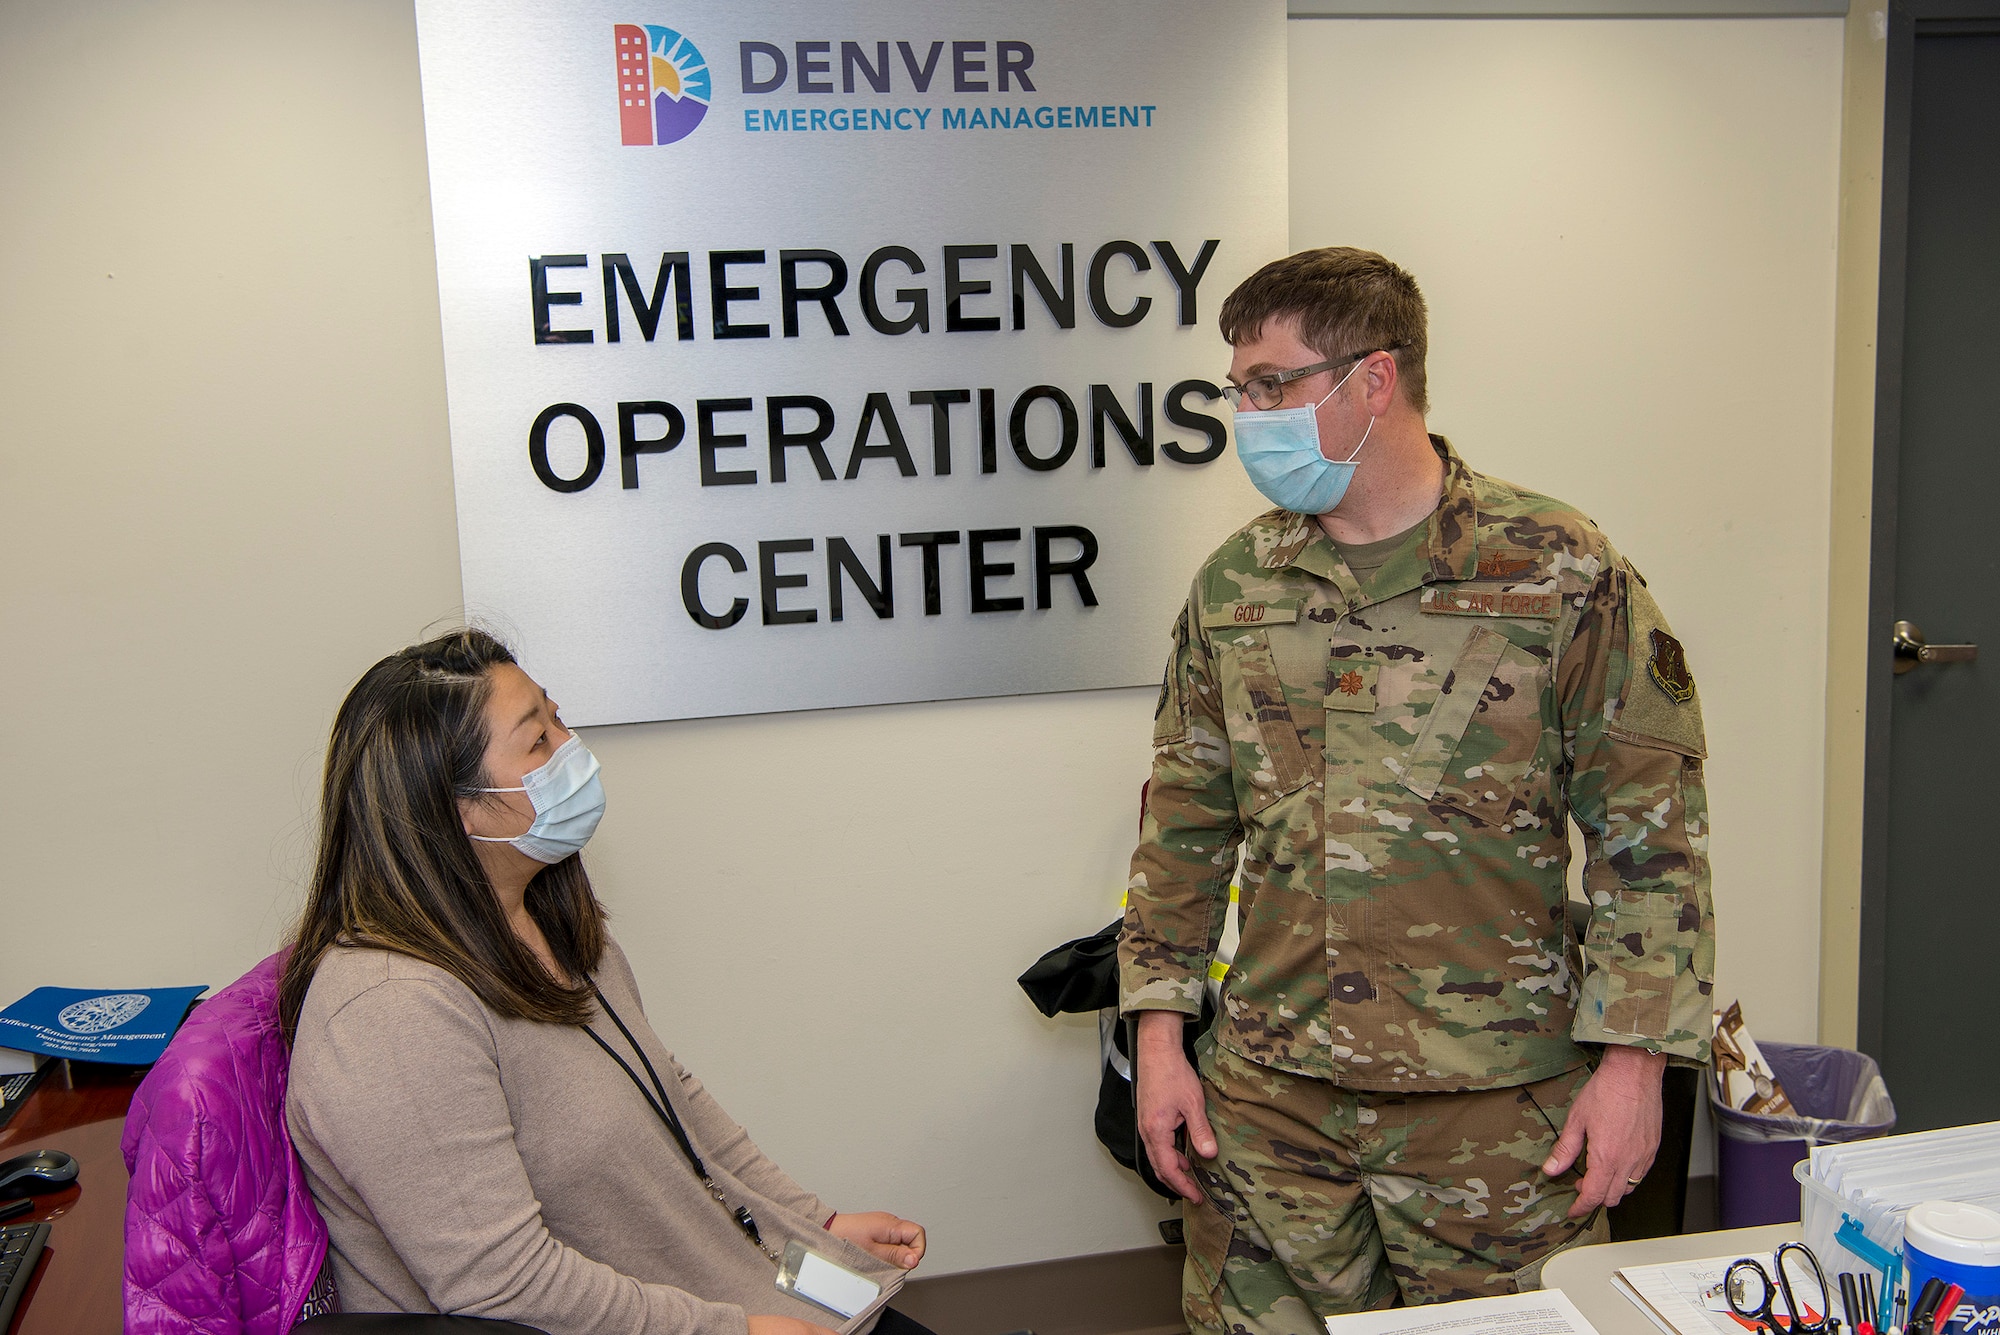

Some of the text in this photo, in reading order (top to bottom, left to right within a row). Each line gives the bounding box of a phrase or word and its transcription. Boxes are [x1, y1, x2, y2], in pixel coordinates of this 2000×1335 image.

[739, 40, 1037, 94] DENVER
[744, 105, 1156, 132] EMERGENCY MANAGEMENT
[529, 239, 1221, 345] EMERGENCY
[528, 379, 1228, 494] OPERATIONS
[680, 525, 1100, 630] CENTER
[1234, 604, 1265, 622] GOLD
[1433, 590, 1551, 614] U.S. AIR FORCE
[0, 1017, 29, 1028] Office
[43, 1027, 98, 1041] Emergency
[101, 1032, 166, 1042] Management
[1948, 1304, 2000, 1332] EXP
